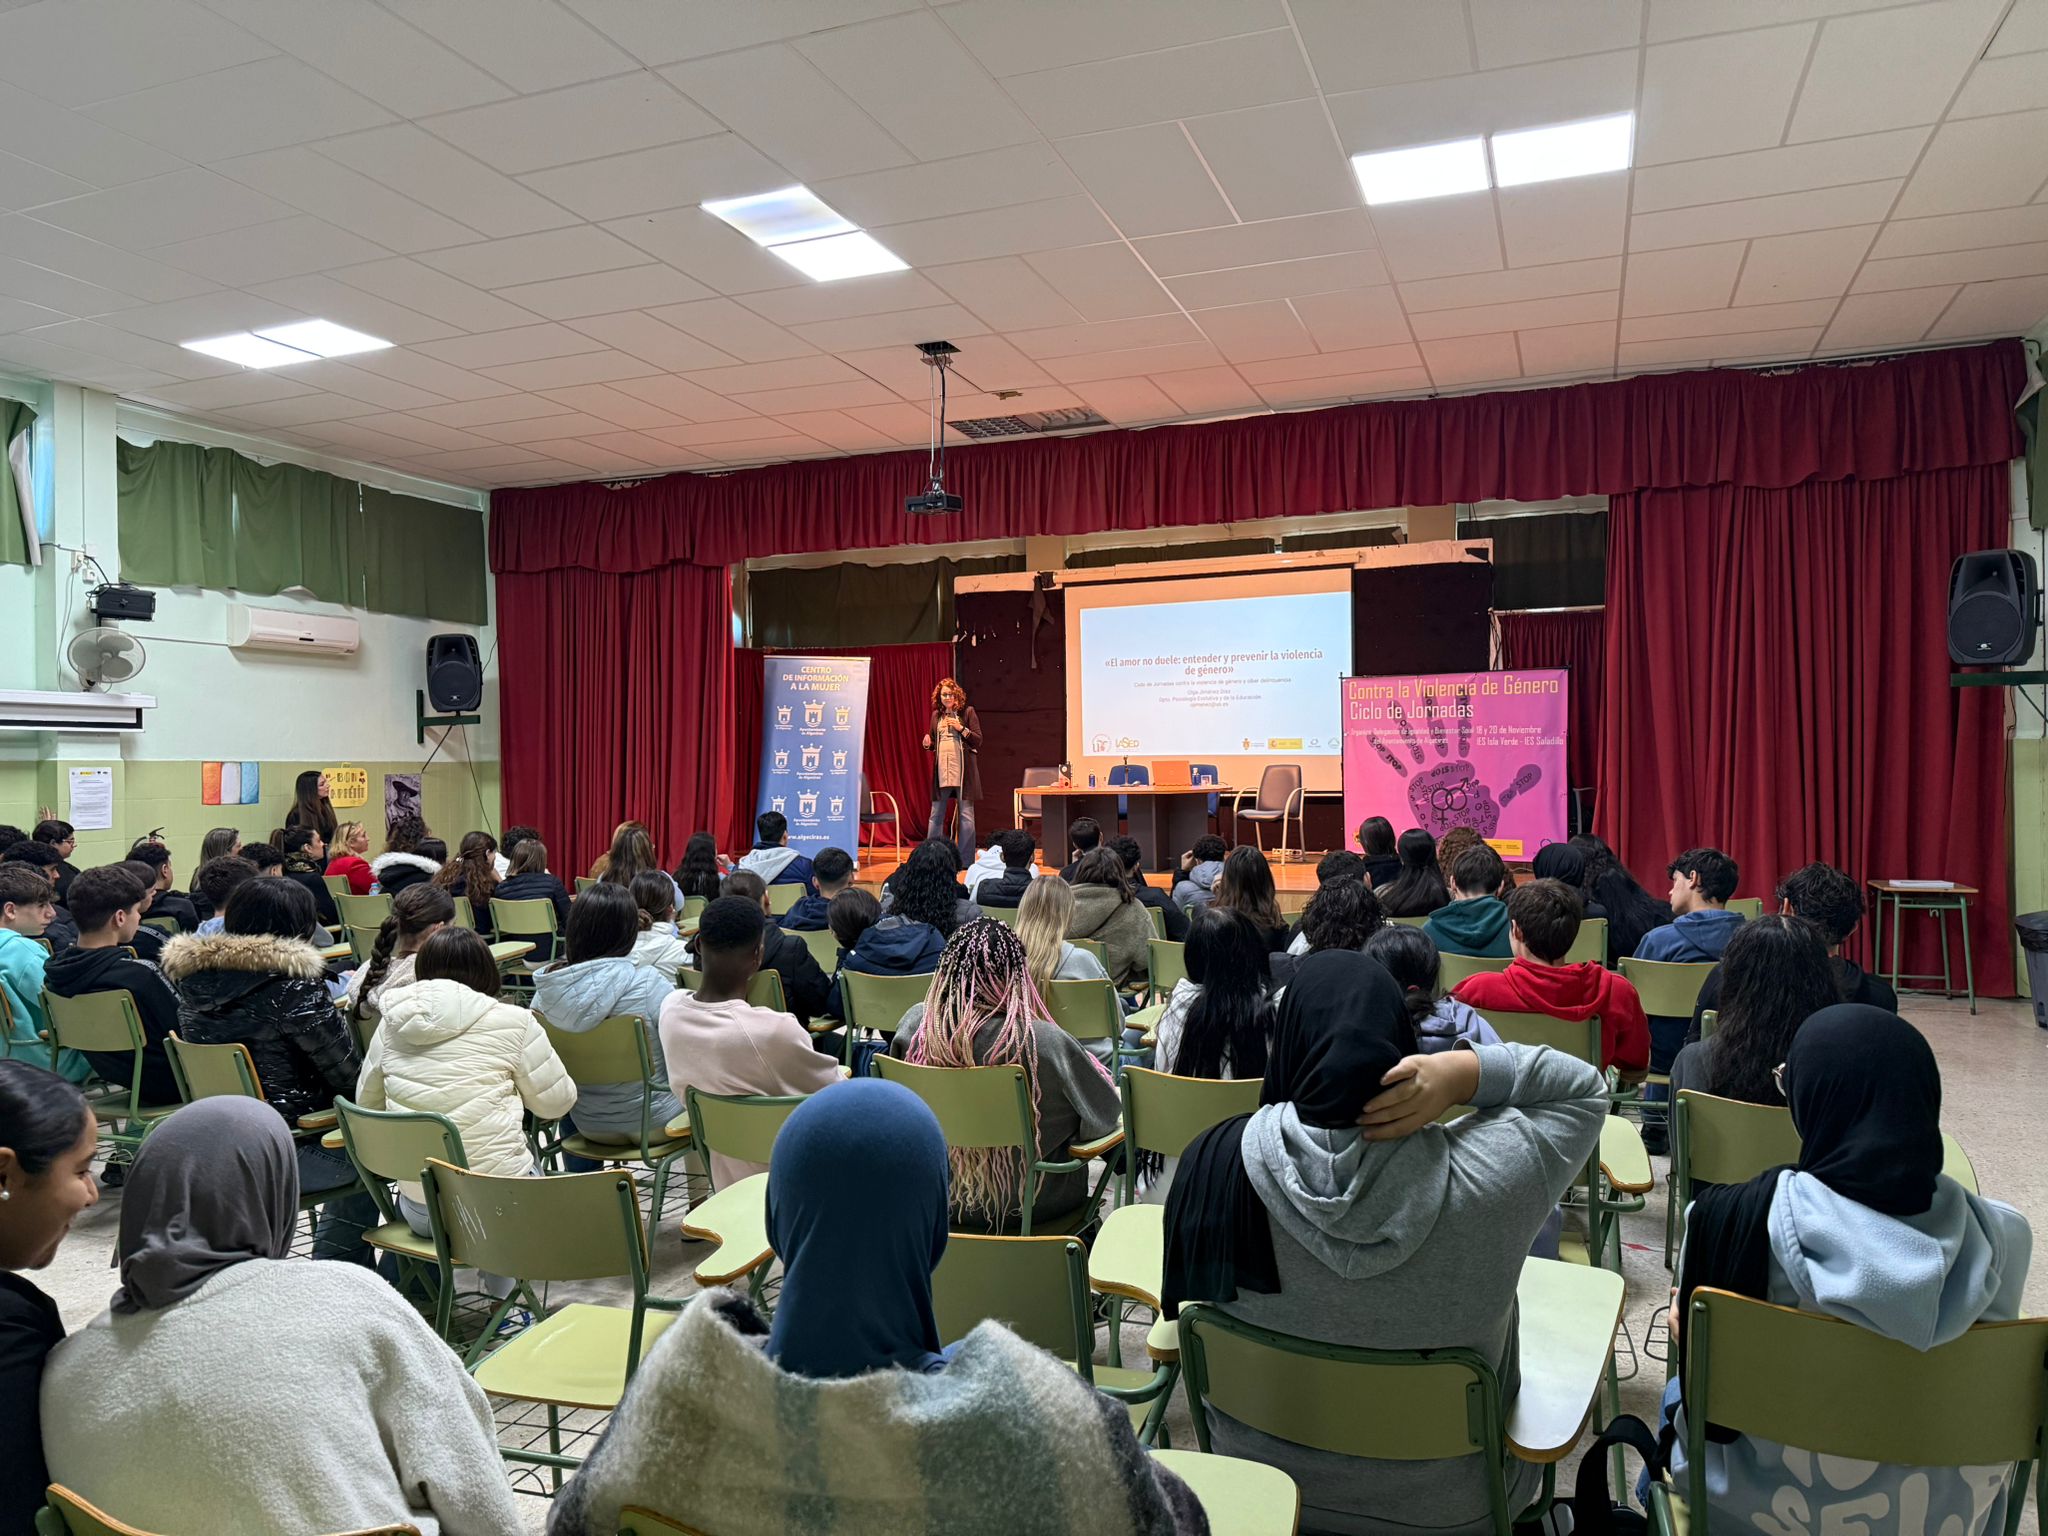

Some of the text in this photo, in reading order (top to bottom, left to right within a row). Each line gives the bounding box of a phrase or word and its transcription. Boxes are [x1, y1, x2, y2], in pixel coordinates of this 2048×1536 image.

[1119, 659, 1140, 667] amor
[1142, 658, 1153, 666] no
[1154, 655, 1181, 666] duele:
[1182, 653, 1222, 665] entender
[1223, 654, 1229, 665] y
[1231, 650, 1269, 664] prevenir
[1270, 650, 1279, 661] la
[1281, 648, 1323, 660] violencia
[800, 666, 832, 674] CENTRO
[1184, 665, 1196, 675] de
[794, 673, 849, 682] INFORMACIÓN
[790, 682, 841, 691] A LA MUJER
[1349, 674, 1559, 701] Contra la Violencia de Género
[1350, 700, 1382, 720] Ciclo
[1387, 700, 1403, 719] de
[1407, 698, 1474, 719] Jornadas
[1489, 725, 1498, 734] 20
[1499, 725, 1507, 734] de
[1508, 725, 1542, 734] Noviembre
[1476, 736, 1486, 746] IES
[1487, 736, 1499, 746] Isla
[1500, 736, 1518, 746] Verde
[1525, 736, 1535, 745] IES
[1536, 735, 1564, 745] Saladillo
[337, 772, 357, 783] BON
[1515, 772, 1533, 788] STOP
[1409, 776, 1425, 792] STOP
[1427, 781, 1445, 792] STOP
[1453, 807, 1471, 820] STOP
